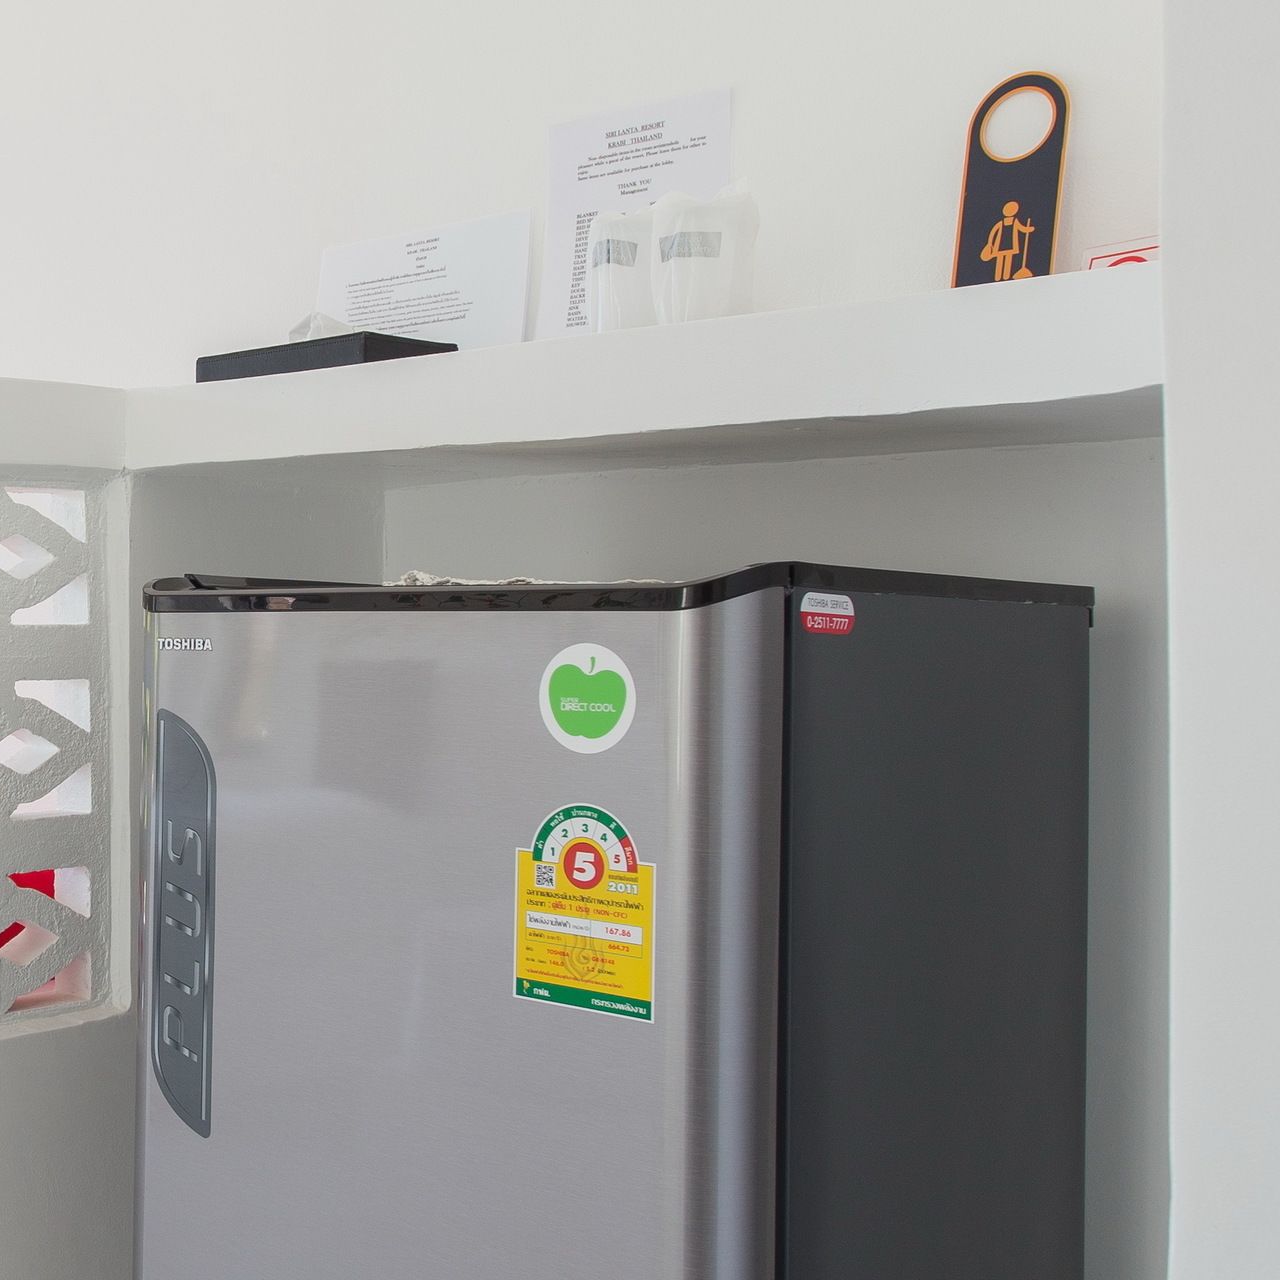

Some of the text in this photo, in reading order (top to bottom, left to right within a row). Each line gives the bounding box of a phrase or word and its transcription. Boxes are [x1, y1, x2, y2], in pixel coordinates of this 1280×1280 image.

[640, 120, 665, 132] RESORT
[607, 132, 663, 149] KRABI THAILAND
[617, 177, 652, 190] THANK YOU
[576, 211, 599, 219] BLANKET
[807, 597, 849, 610] TOSHIBA SERVICE
[807, 616, 849, 630] 0-2511-7777
[157, 637, 213, 651] TOSHIBA
[560, 702, 616, 713] DIRECT COOL
[561, 828, 569, 838] 2
[581, 823, 589, 833] 3
[600, 832, 608, 843] 4
[550, 846, 556, 857] 1
[613, 854, 621, 864] 5
[572, 851, 596, 882] 5
[607, 881, 639, 896] 2011
[603, 926, 632, 939] 167.86
[163, 818, 202, 1064] PLUS
